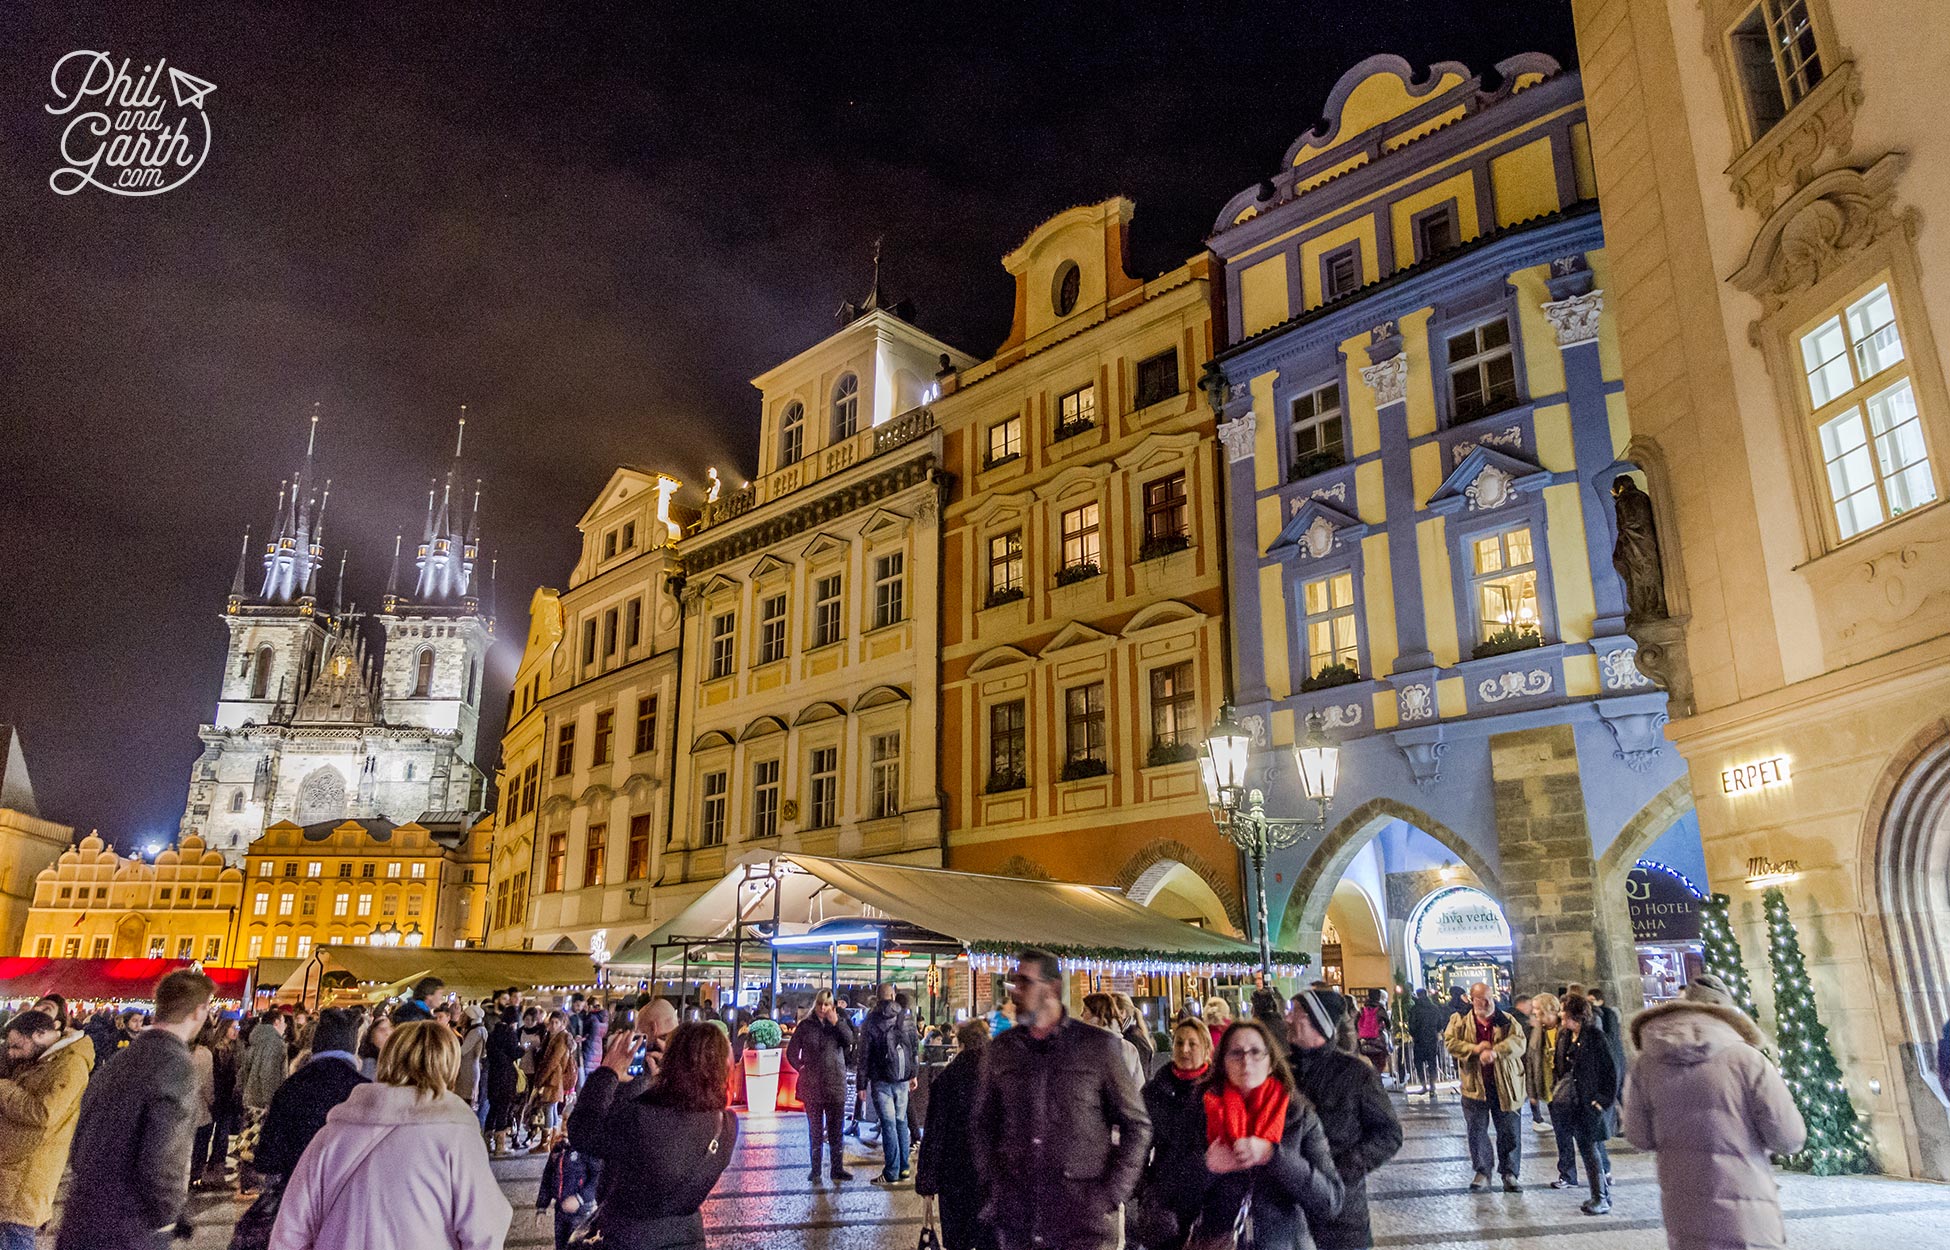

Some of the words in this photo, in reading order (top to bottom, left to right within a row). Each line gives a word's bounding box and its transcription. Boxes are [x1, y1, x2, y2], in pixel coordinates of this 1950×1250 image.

[1721, 757, 1783, 793] ERPET
[1645, 902, 1693, 915] HOTEL
[1631, 919, 1667, 930] RAHA
